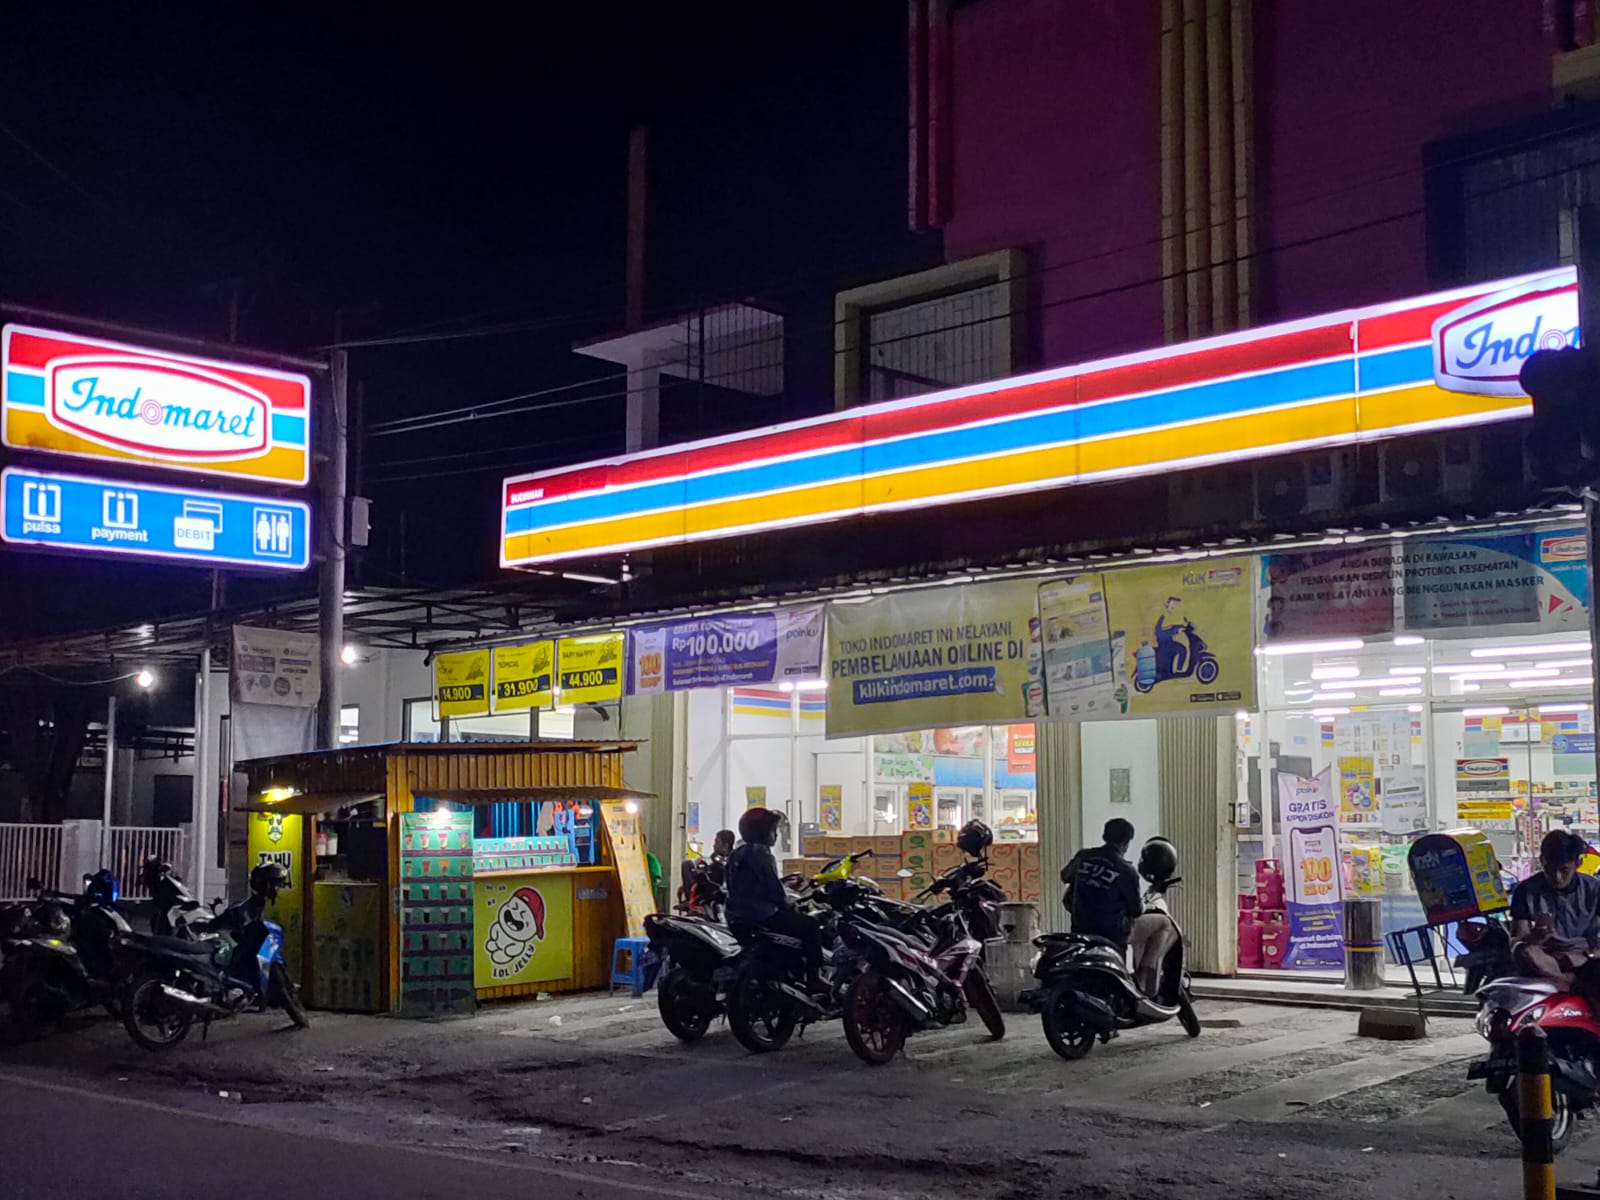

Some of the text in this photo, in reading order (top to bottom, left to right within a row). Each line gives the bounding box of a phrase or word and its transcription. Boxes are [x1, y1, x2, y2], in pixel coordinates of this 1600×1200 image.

[1456, 315, 1581, 370] Indo
[63, 377, 256, 438] Indomaret
[22, 520, 61, 534] pulsa
[91, 525, 149, 543] payment
[177, 527, 212, 542] DEBIT
[1413, 553, 1424, 562] DI
[1405, 564, 1457, 577] PROTOKOL
[1459, 560, 1519, 574] KESEHATAN
[1374, 586, 1404, 597] YANG
[1406, 579, 1493, 595] MENGGUNAKAN
[1495, 575, 1545, 588] MASKER
[839, 638, 867, 654] TOKO
[869, 630, 933, 650] INDOMARET
[937, 628, 954, 643] INI
[1008, 639, 1024, 659] DI
[568, 670, 604, 687] 44.900
[503, 680, 539, 696] 31.900
[493, 944, 535, 978] LOL JELLY
